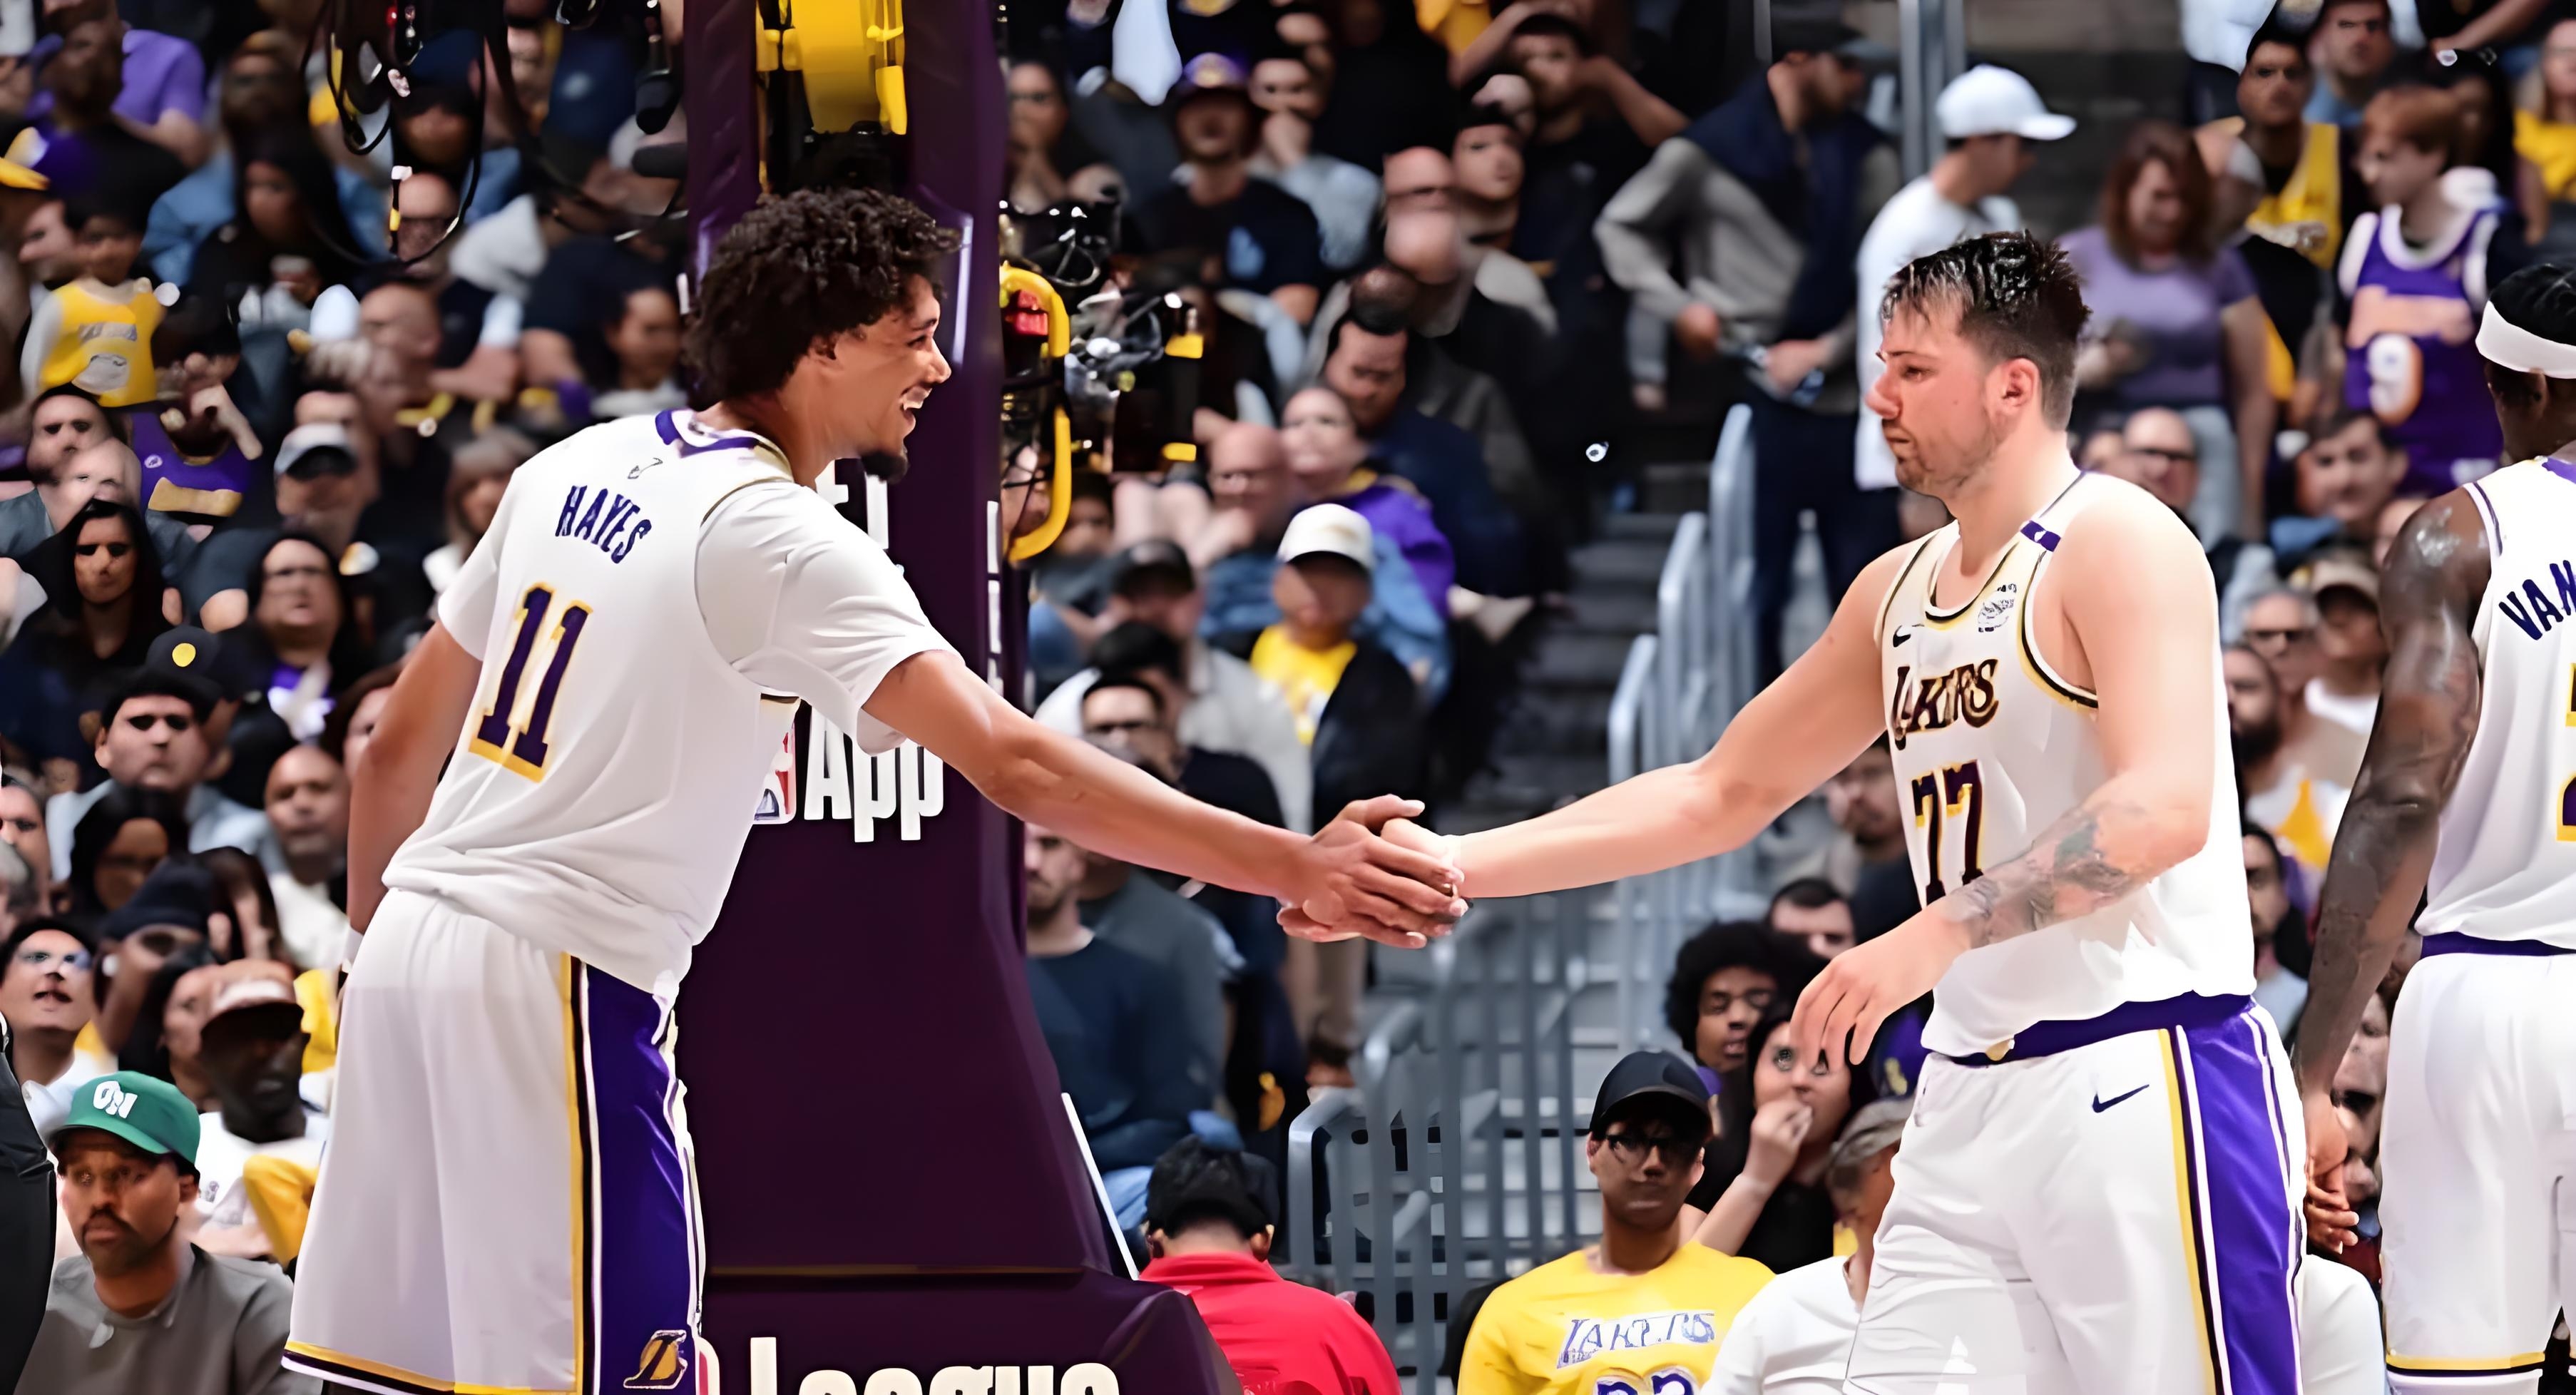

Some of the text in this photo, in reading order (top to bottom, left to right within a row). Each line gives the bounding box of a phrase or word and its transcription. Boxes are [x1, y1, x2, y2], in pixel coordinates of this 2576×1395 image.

[555, 485, 653, 564] HAYES
[469, 582, 593, 783] 11
[804, 703, 944, 843] App
[1911, 759, 1985, 906] 77
